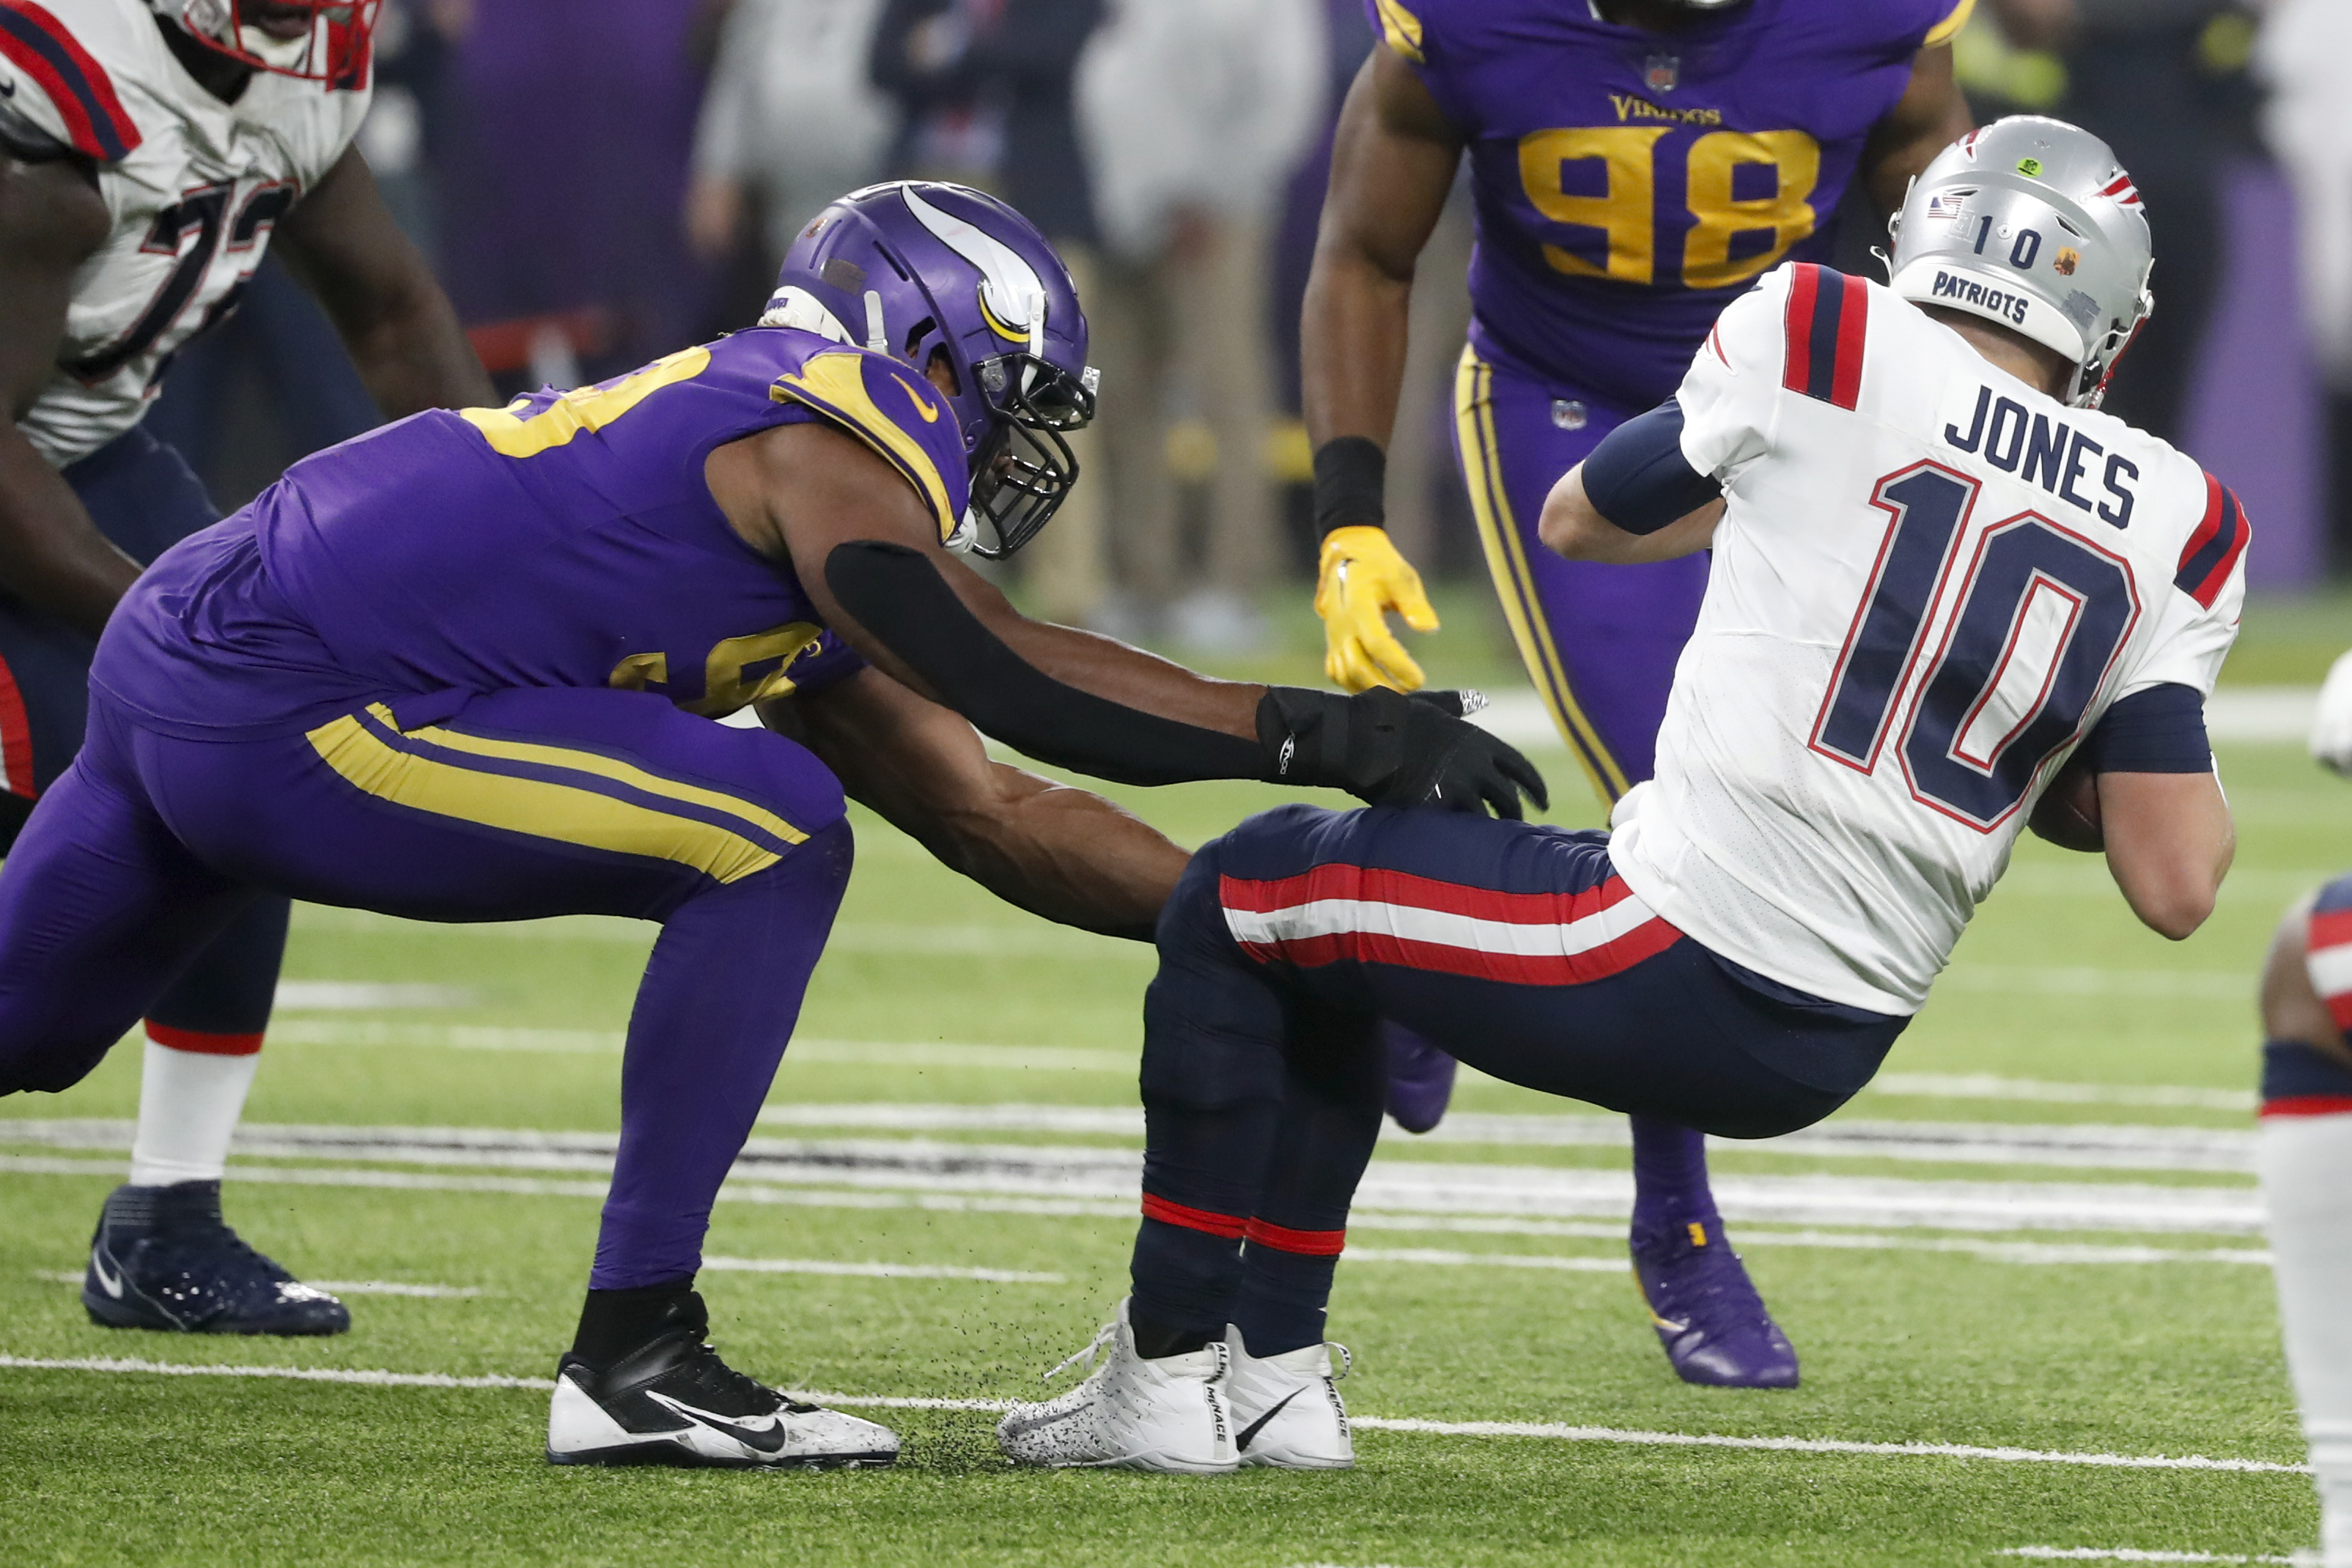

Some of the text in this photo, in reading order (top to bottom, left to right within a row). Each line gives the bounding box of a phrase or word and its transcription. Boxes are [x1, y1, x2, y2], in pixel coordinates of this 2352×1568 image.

[1518, 126, 1821, 289] 98
[1931, 270, 2029, 325] PATRIOTS
[1944, 384, 2139, 530] JONES
[1807, 456, 2142, 835] 10
[1206, 1386, 1227, 1443] MENACE
[1322, 1376, 1348, 1438] MENACE
